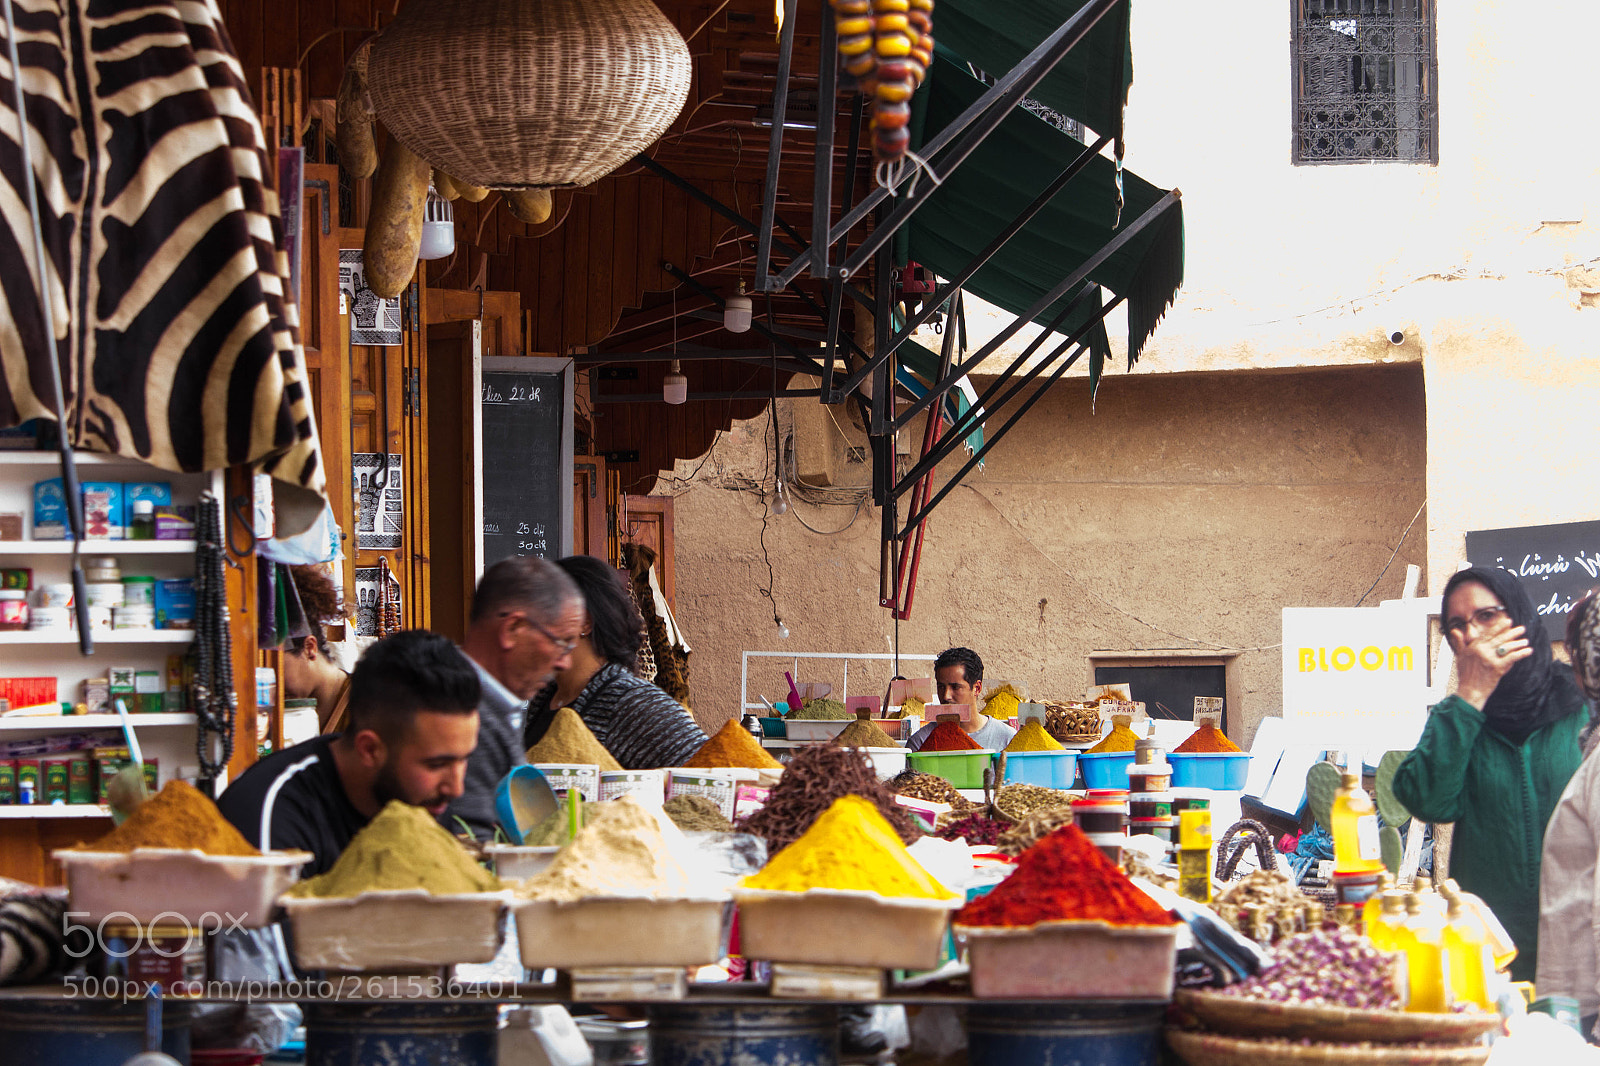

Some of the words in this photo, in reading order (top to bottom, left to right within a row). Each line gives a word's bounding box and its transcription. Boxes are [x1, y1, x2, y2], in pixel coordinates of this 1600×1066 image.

[509, 387, 526, 401] 22
[516, 522, 530, 535] 25
[1298, 645, 1414, 672] BLOOM
